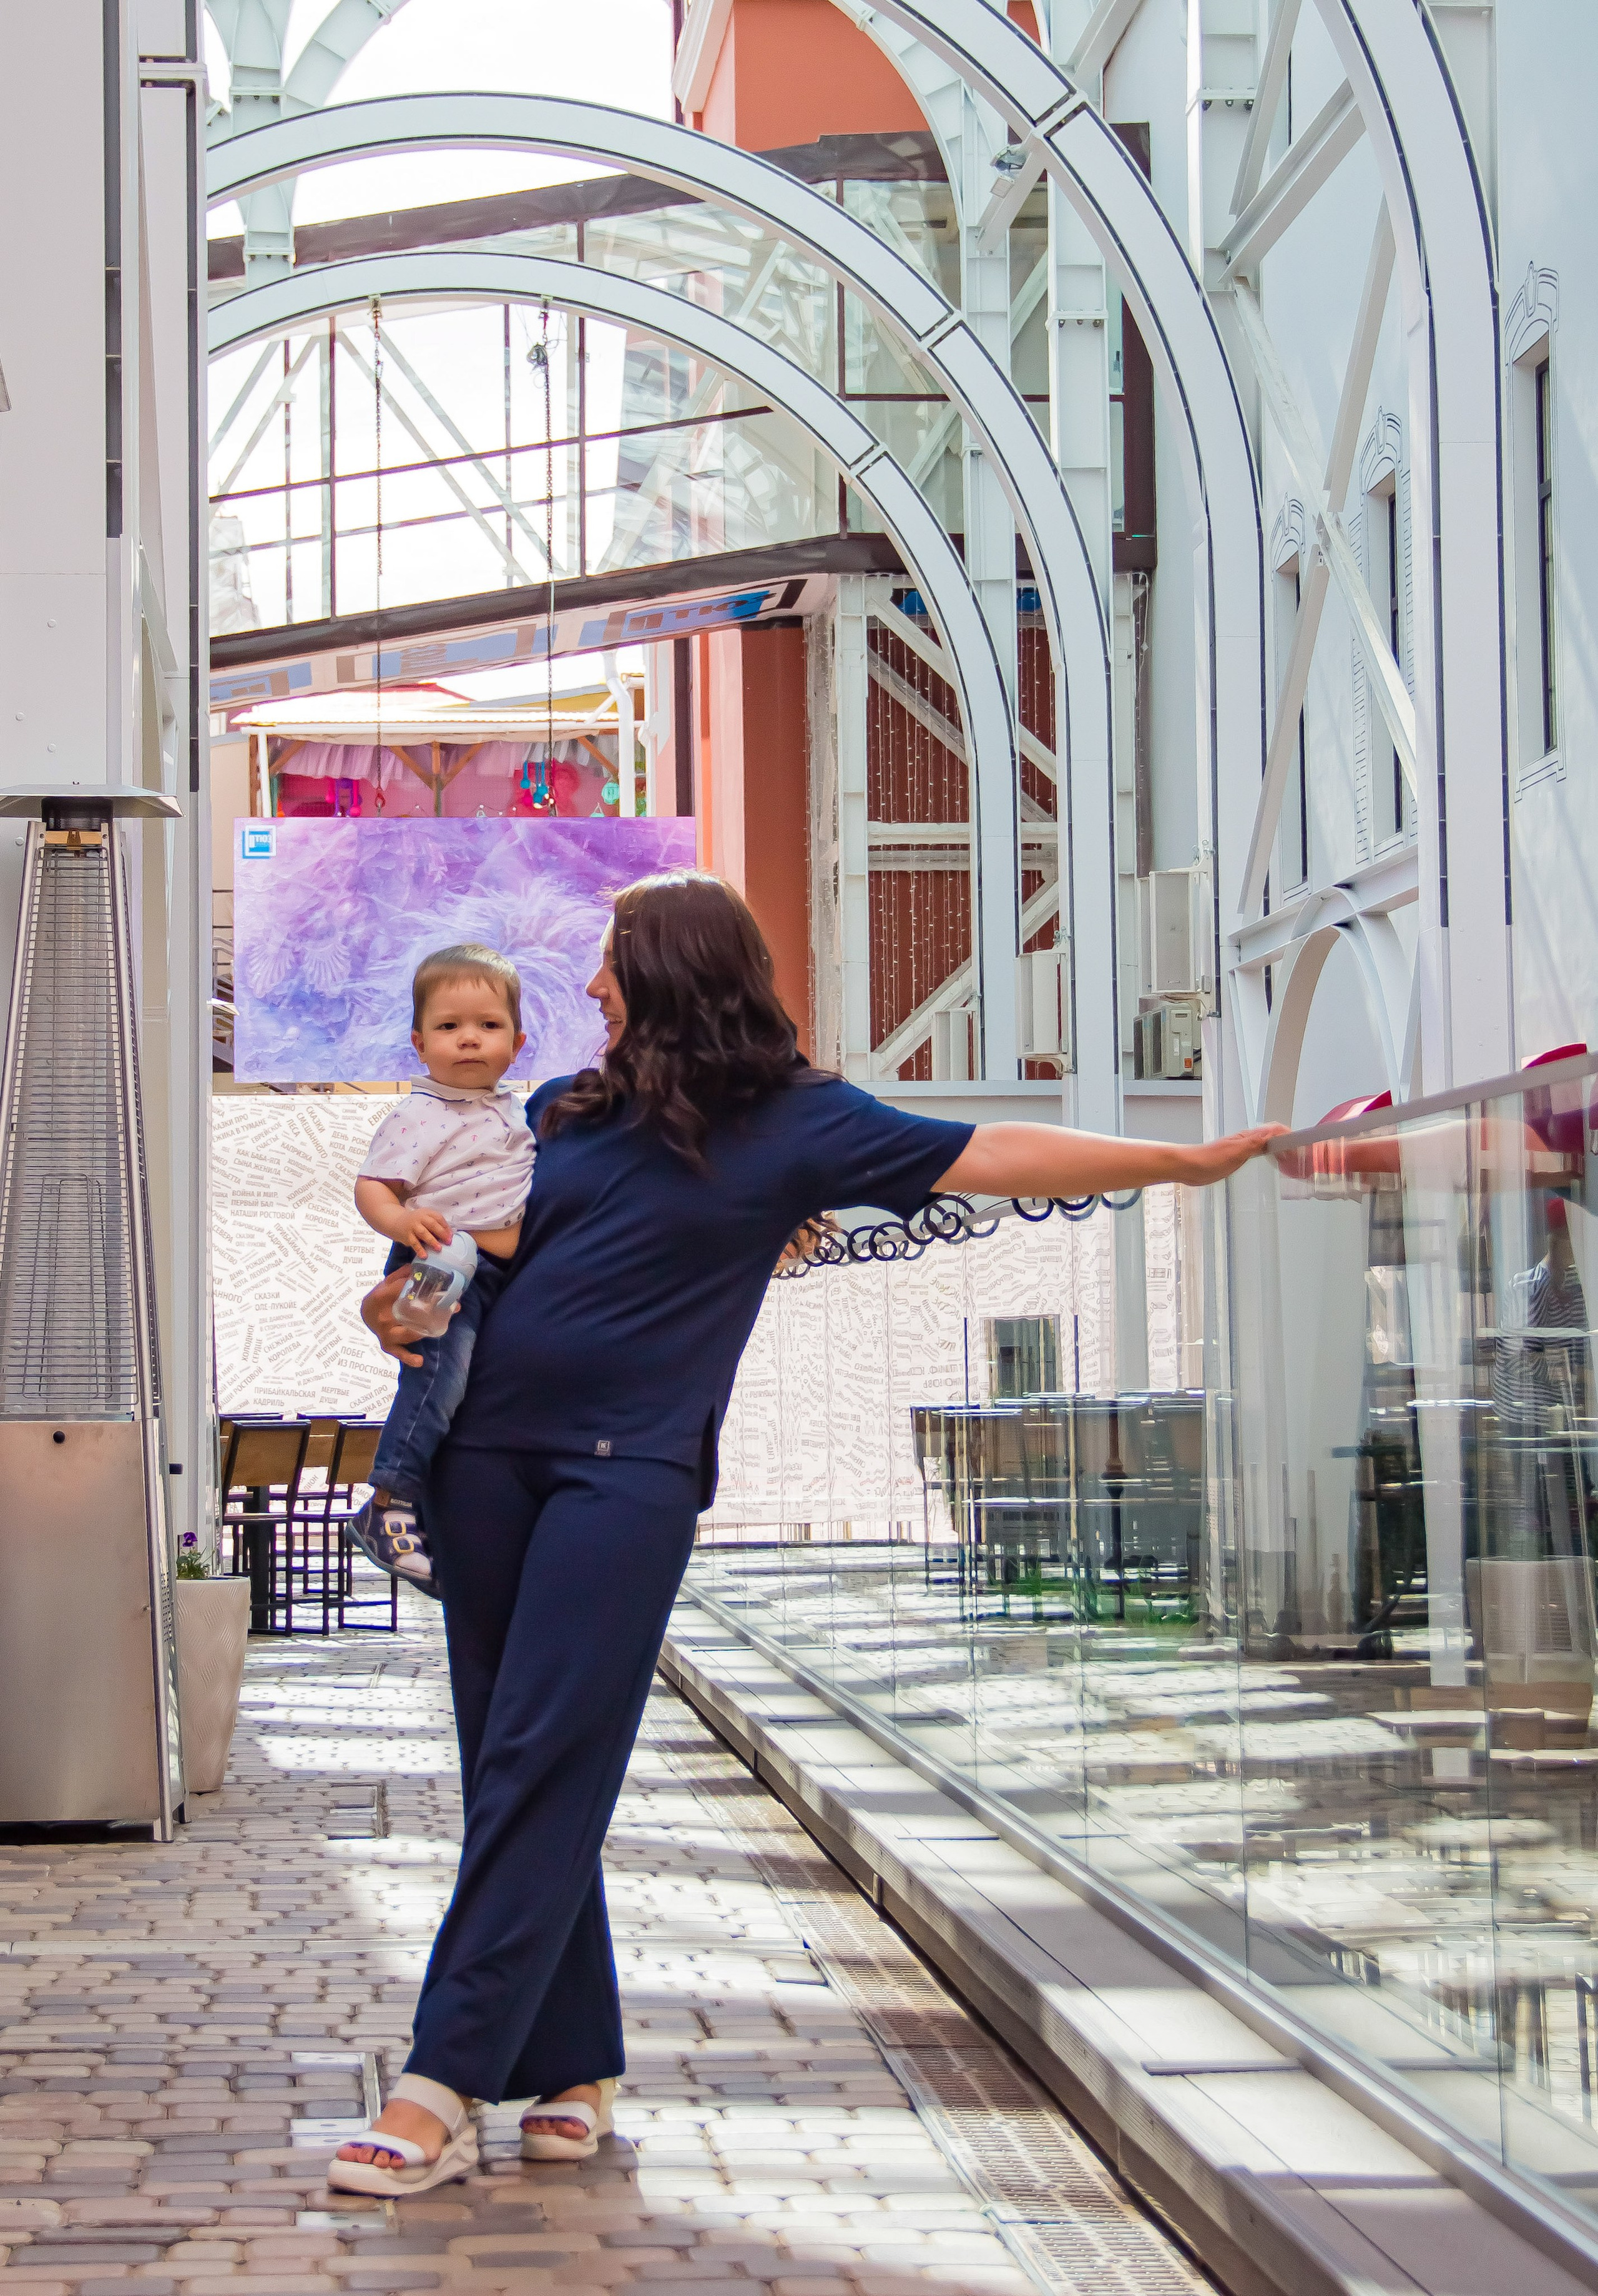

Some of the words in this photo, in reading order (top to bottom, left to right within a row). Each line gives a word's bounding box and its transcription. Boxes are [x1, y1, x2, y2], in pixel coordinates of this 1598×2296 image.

[212, 1119, 233, 1131] КАЗКИ
[235, 1113, 248, 1124] ПРО
[241, 1118, 267, 1132] ТУМАНЕ
[287, 1119, 301, 1137] ЛЕСА
[306, 1106, 325, 1133] СКАЗКИ
[256, 1134, 280, 1151] СЧАСТЬЕ
[297, 1112, 328, 1158] СМЕШАННОГО
[331, 1130, 349, 1141] ДЕНЬ
[281, 1141, 313, 1162] КАПРИЗКА
[329, 1141, 345, 1151] КОТА
[237, 1148, 250, 1157] КАК
[250, 1151, 281, 1165] БАБА-ЯГА
[233, 1158, 252, 1168] СЫНА
[253, 1163, 281, 1176] ЖЕНИЛА
[335, 1162, 357, 1181] СКАЗКИ
[232, 1189, 255, 1197] ВОЙНА
[286, 1178, 318, 1201] ХОЛОДНОЕ
[292, 1191, 315, 1209] СЕРДЦЕ
[260, 1211, 295, 1219] РОСТОВОЙ
[308, 1203, 339, 1217] СНЕЖНАЯ
[305, 1213, 339, 1228] КОРОЛЕВА
[212, 1224, 233, 1243] СЕВЕРА
[267, 1230, 289, 1258] КАДРИЛЬ
[274, 1223, 318, 1274] ПРИБАЙКАЛЬСКАЯ
[314, 1244, 332, 1257] РОМЕО
[344, 1245, 375, 1254] МЕРТВЫЕ
[229, 1269, 244, 1281] ДЕНЬ
[245, 1250, 277, 1271] РОЖДЕНИЯ
[233, 1277, 248, 1289] КОТА
[250, 1258, 283, 1280] ЛЕОПОЛЬДА
[254, 1292, 280, 1300] СКАЗКИ
[300, 1297, 317, 1313] ВОЙНА
[305, 1301, 325, 1319] ПЕРВЫЙ
[325, 1292, 335, 1303] БАЛ
[311, 1307, 330, 1326] НАТАШИ
[329, 1287, 353, 1309] РОСТОВОЙ
[242, 1324, 255, 1362] ХОЛОДНОЕ
[252, 1338, 263, 1363] СЕРДЦЕ
[263, 1332, 294, 1353] СНЕЖНАЯ
[315, 1334, 343, 1360] МЕРТВЫЕ
[268, 1341, 301, 1363] КОРОЛЕВА
[323, 1351, 340, 1369] ДУШИ
[340, 1346, 365, 1359] ПОБЕГ
[337, 1358, 347, 1367] ИЗ
[227, 1373, 240, 1387] БАЛ
[233, 1365, 263, 1395] РОСТОВОЙ
[295, 1367, 314, 1377] РОМЕО
[254, 1387, 316, 1398] ПРИБАЙКАЛЬСКАЯ
[319, 1396, 338, 1404] ДУШИ
[321, 1386, 350, 1396] МЕРТВЫЕ
[350, 1392, 375, 1409] СКАЗКИ
[374, 1384, 388, 1396] ПРО
[253, 1398, 285, 1407] КАДРИЛЬ
